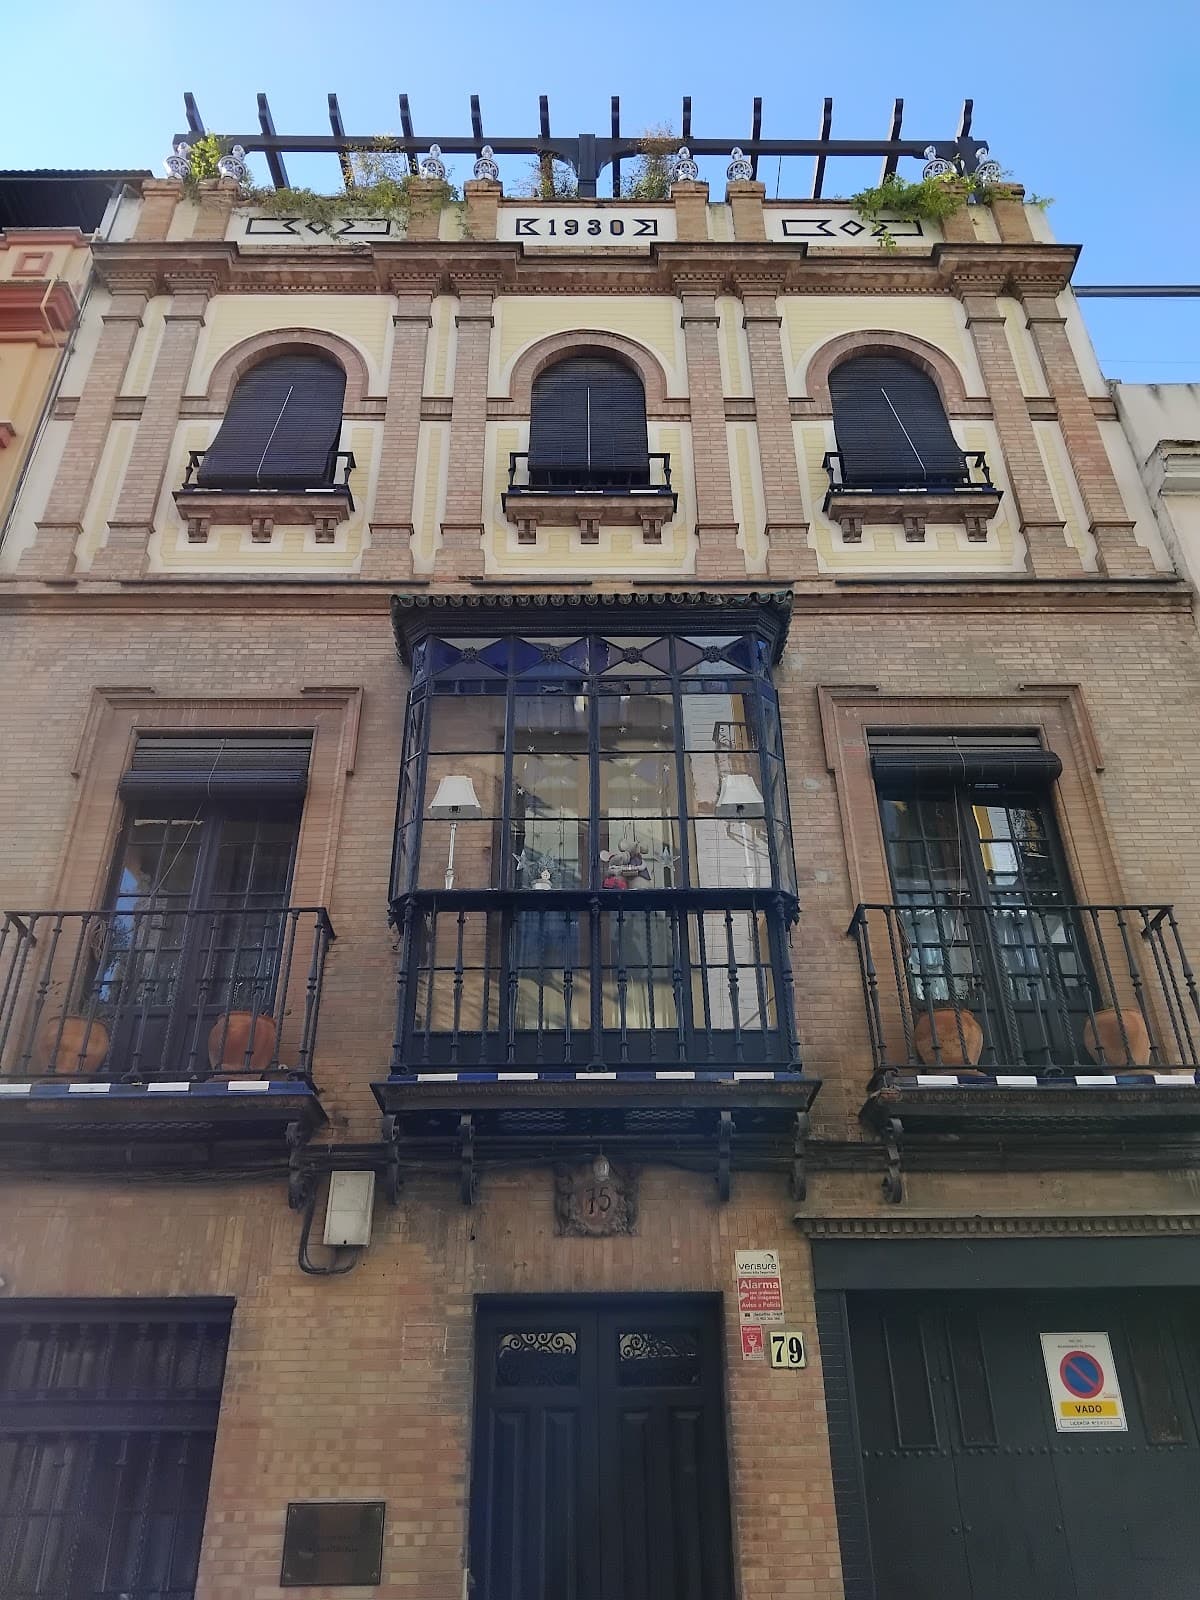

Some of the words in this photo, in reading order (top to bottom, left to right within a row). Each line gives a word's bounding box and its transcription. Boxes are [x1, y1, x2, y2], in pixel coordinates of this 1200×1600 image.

[548, 219, 625, 236] 1930
[740, 1280, 779, 1289] Alarma
[772, 1335, 803, 1364] 79
[1075, 1405, 1102, 1413] VADO
